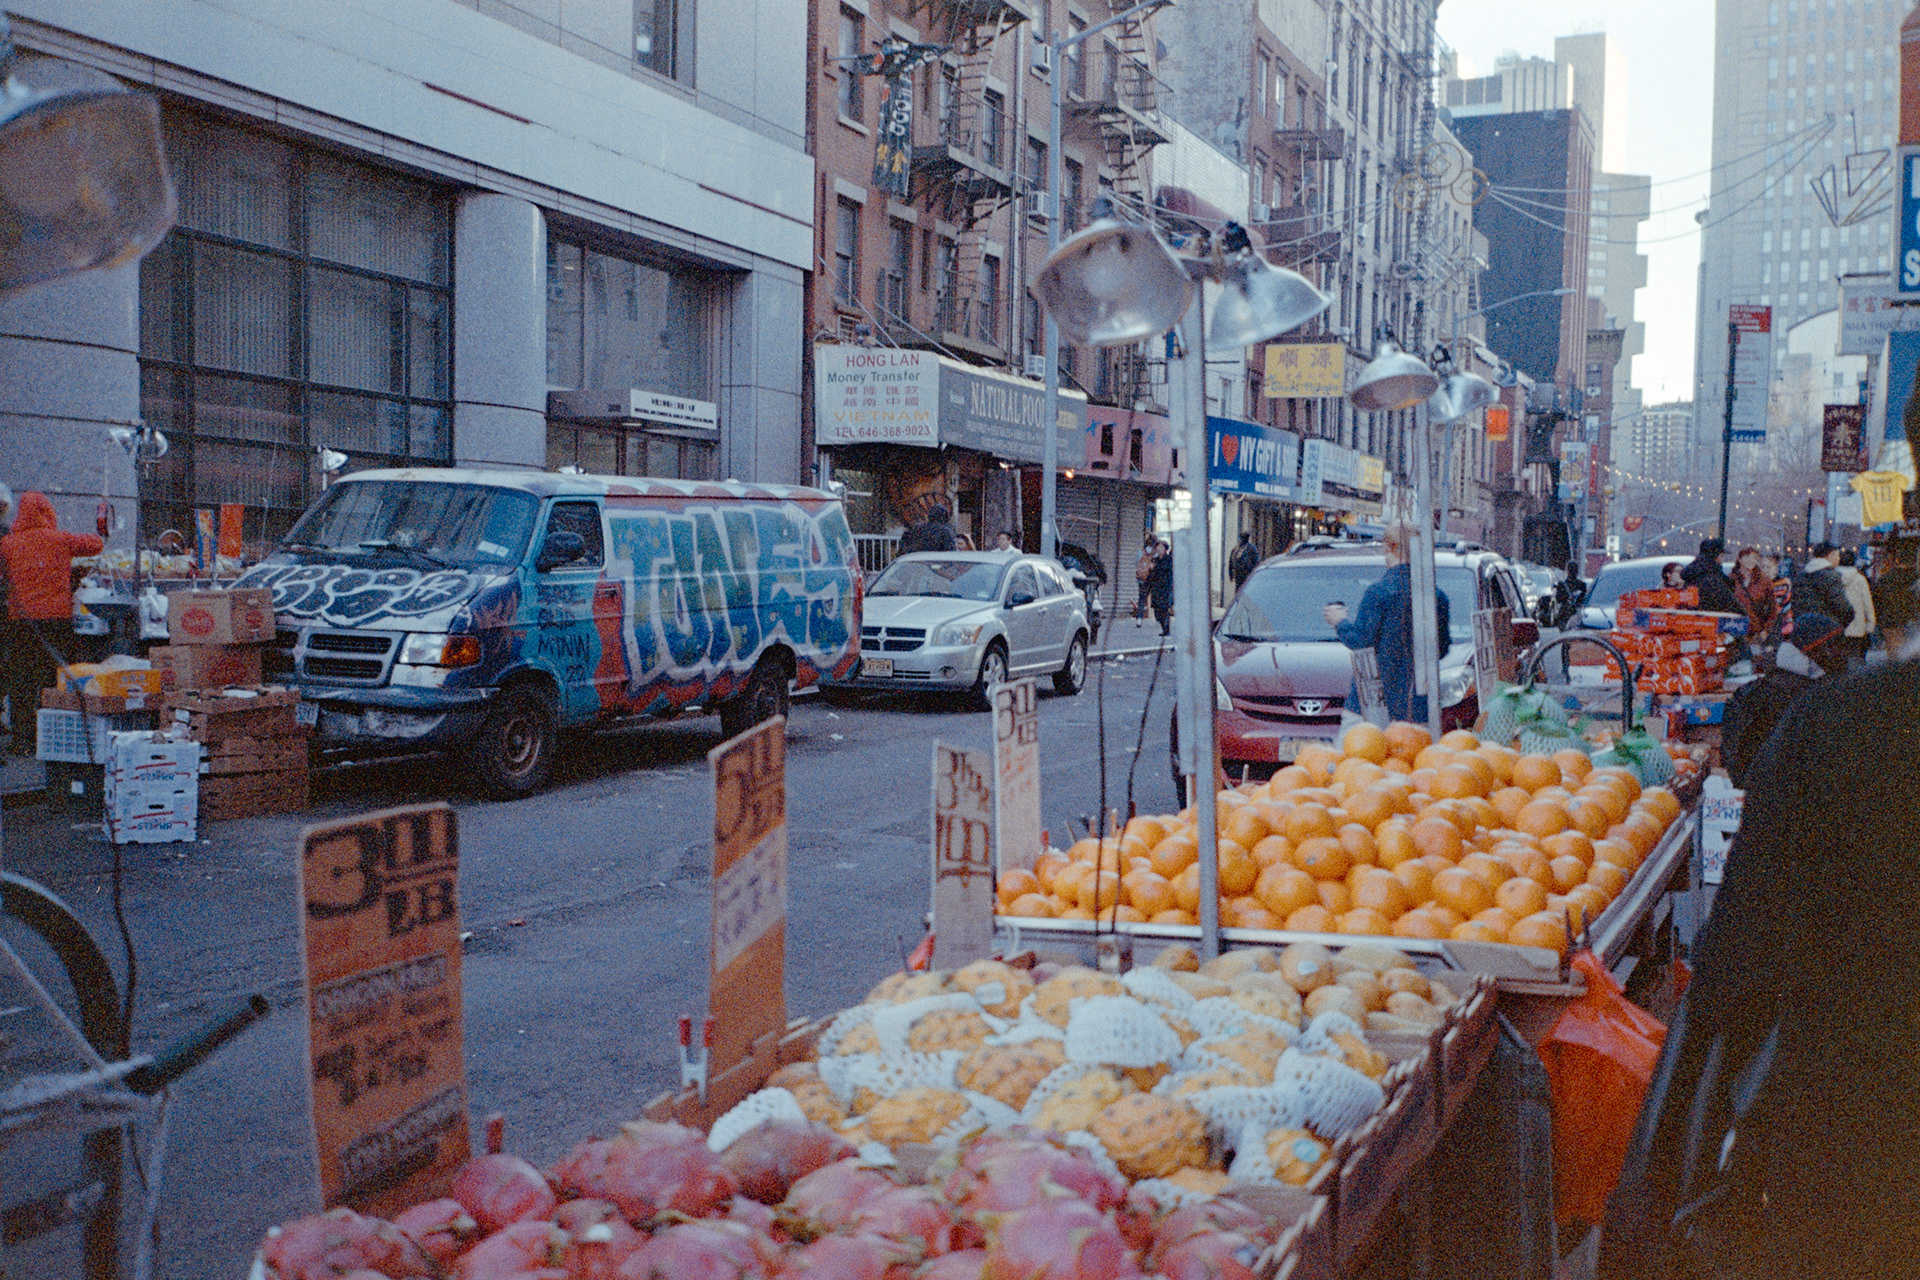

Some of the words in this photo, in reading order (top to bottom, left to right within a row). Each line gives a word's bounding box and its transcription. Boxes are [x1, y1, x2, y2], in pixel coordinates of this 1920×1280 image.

[827, 372, 867, 385] Money
[871, 370, 920, 383] Transfer
[846, 353, 886, 368] HONG
[890, 353, 920, 367] LAN
[833, 410, 930, 422] VIETNAM
[970, 380, 1021, 424] NATURAL
[858, 425, 931, 438] 646-368-9023
[1239, 435, 1256, 472] NY
[1256, 438, 1276, 476] GIFT
[997, 688, 1016, 743] 3
[1017, 720, 1039, 747] LB
[305, 824, 382, 920] 3
[386, 878, 457, 938] LB
